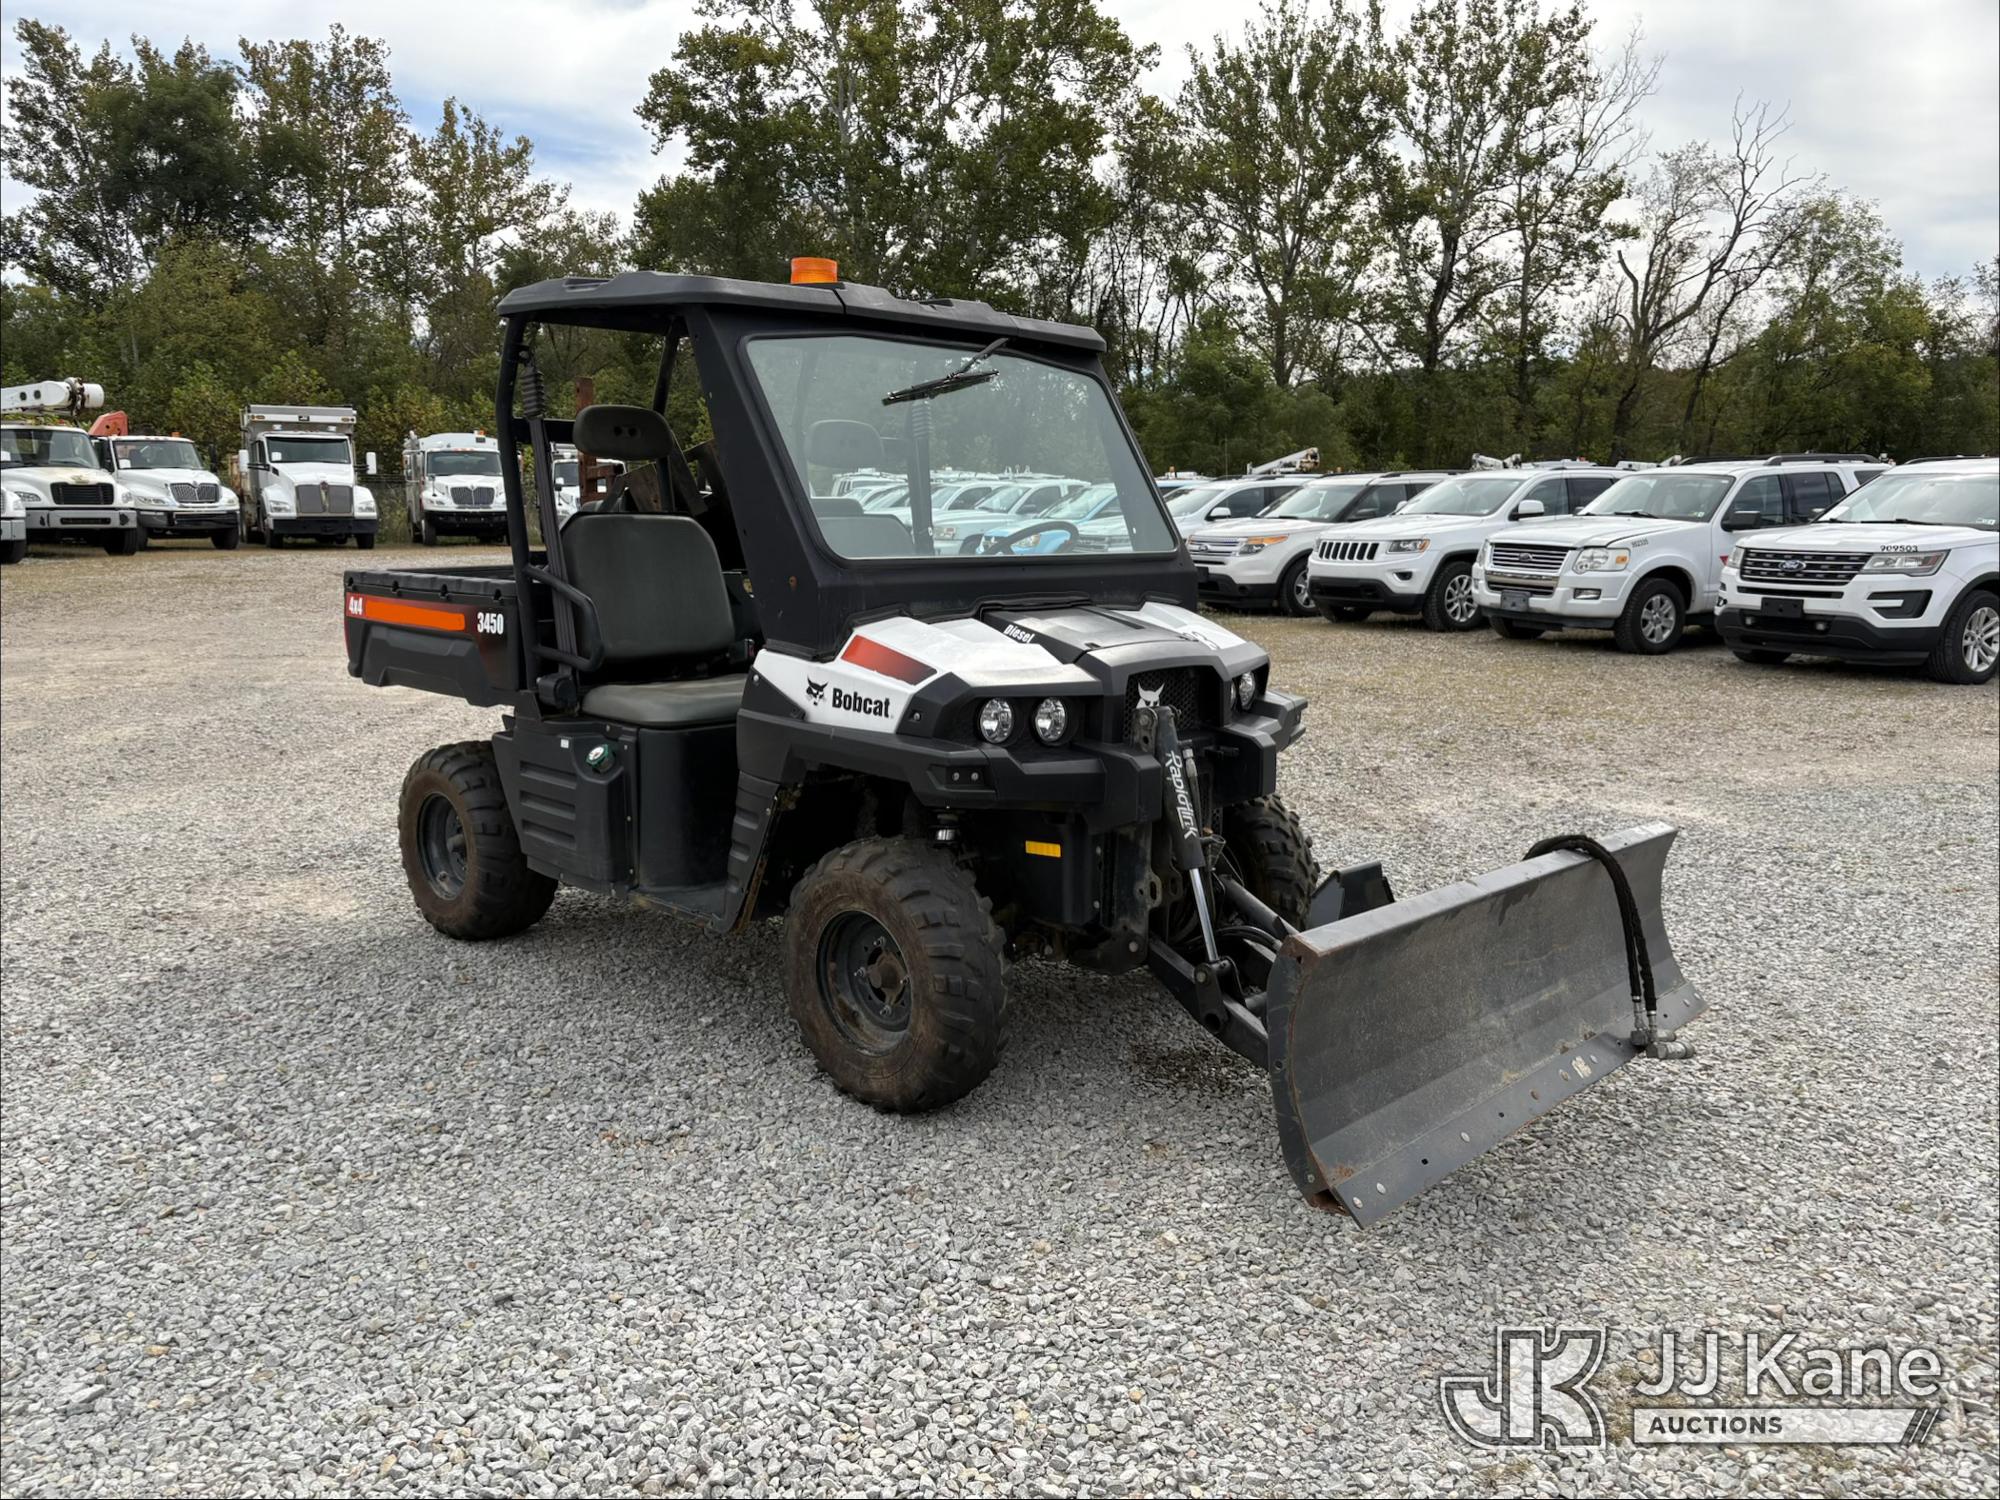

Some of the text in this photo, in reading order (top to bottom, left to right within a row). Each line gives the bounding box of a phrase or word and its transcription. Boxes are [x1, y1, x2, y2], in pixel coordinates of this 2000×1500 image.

[348, 596, 363, 616] 4x4
[476, 611, 504, 635] 3450
[1003, 624, 1036, 643] Diesel
[832, 687, 890, 718] Bobcat
